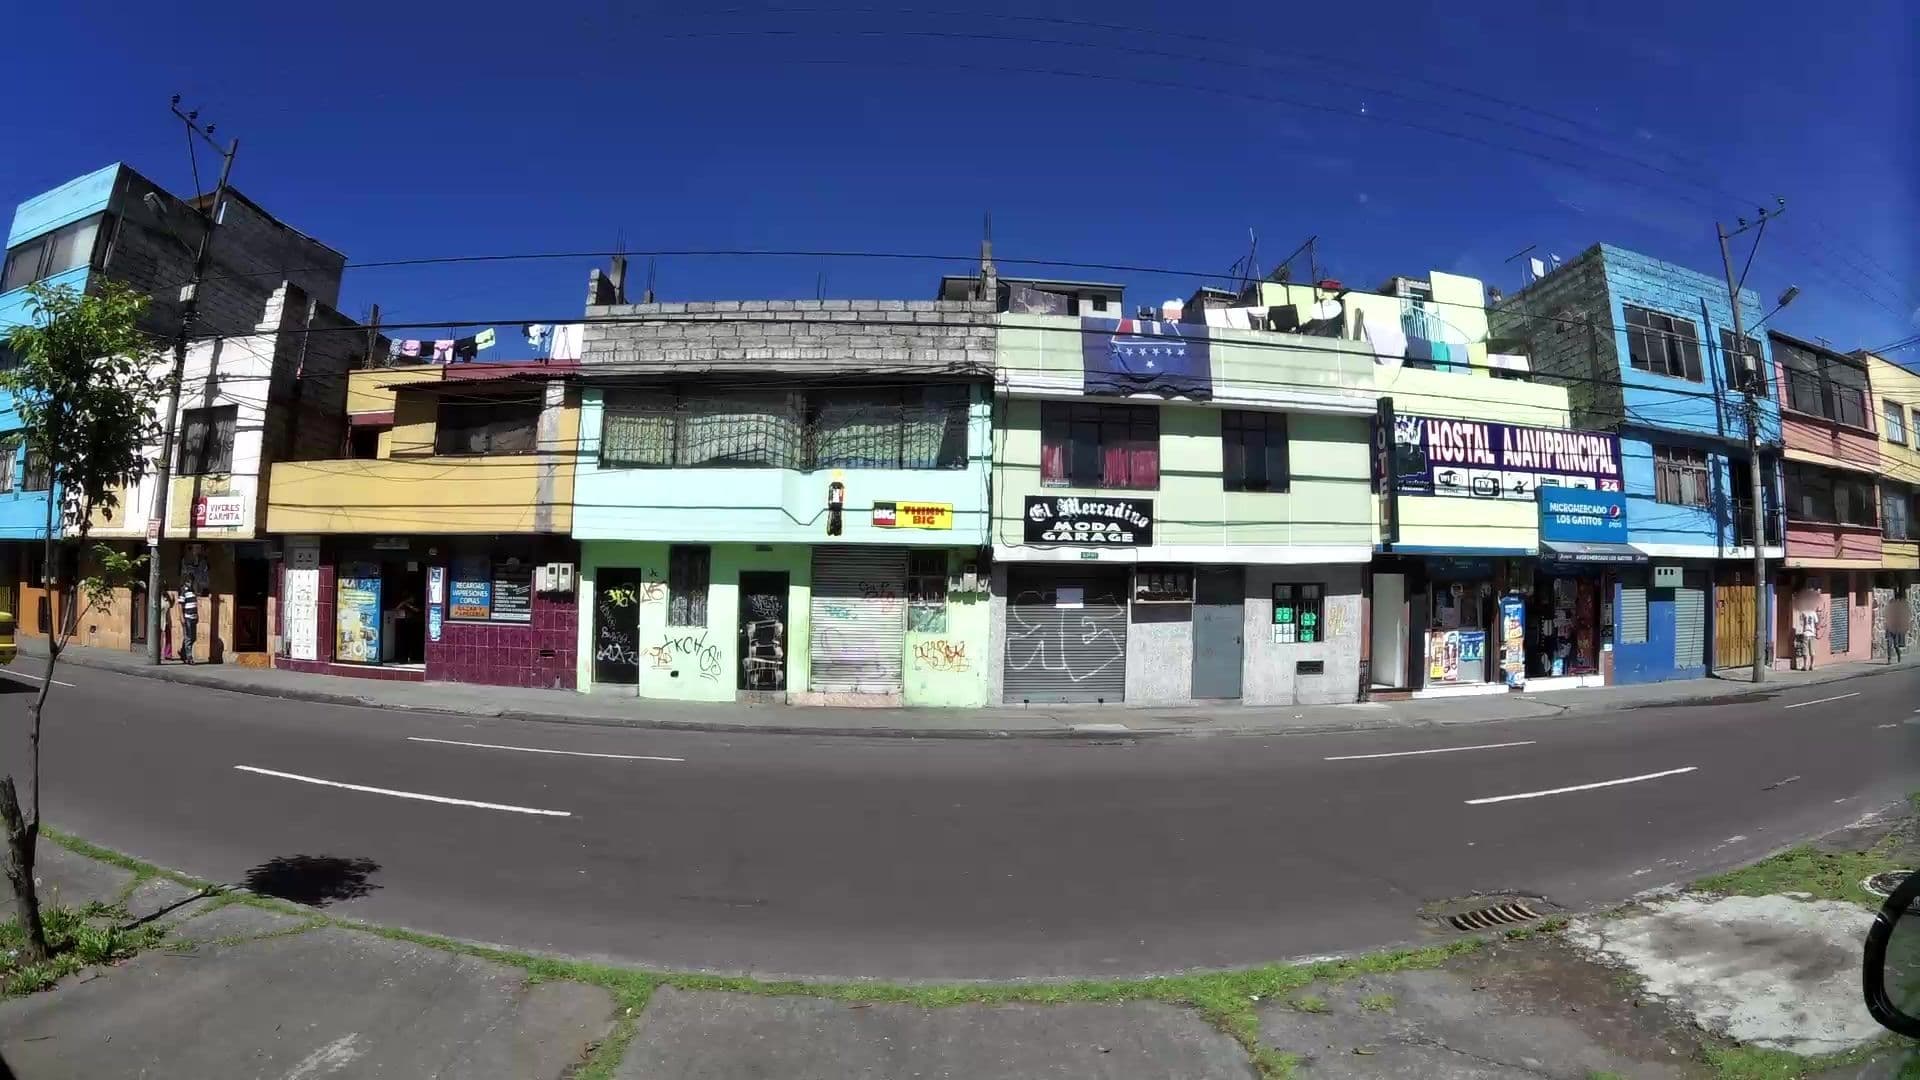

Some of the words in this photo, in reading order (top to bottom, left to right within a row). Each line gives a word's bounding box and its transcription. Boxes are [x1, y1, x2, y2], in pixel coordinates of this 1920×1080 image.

[1427, 420, 1495, 464] HOSTAL
[1503, 427, 1617, 474] AJAVIPRINCIPAL
[1478, 479, 1490, 489] TV
[1601, 481, 1619, 492] 24
[904, 506, 945, 516] THINK
[1029, 503, 1053, 521] El
[1056, 497, 1149, 528] Mercadino
[1549, 502, 1608, 514] MICROMERCADO
[208, 513, 240, 521] CARMITA
[912, 516, 935, 524] BIG
[1556, 514, 1570, 524] LOS
[1572, 516, 1602, 526] GATITOS
[1053, 522, 1121, 531] MODA
[1041, 532, 1134, 542] GARAGE
